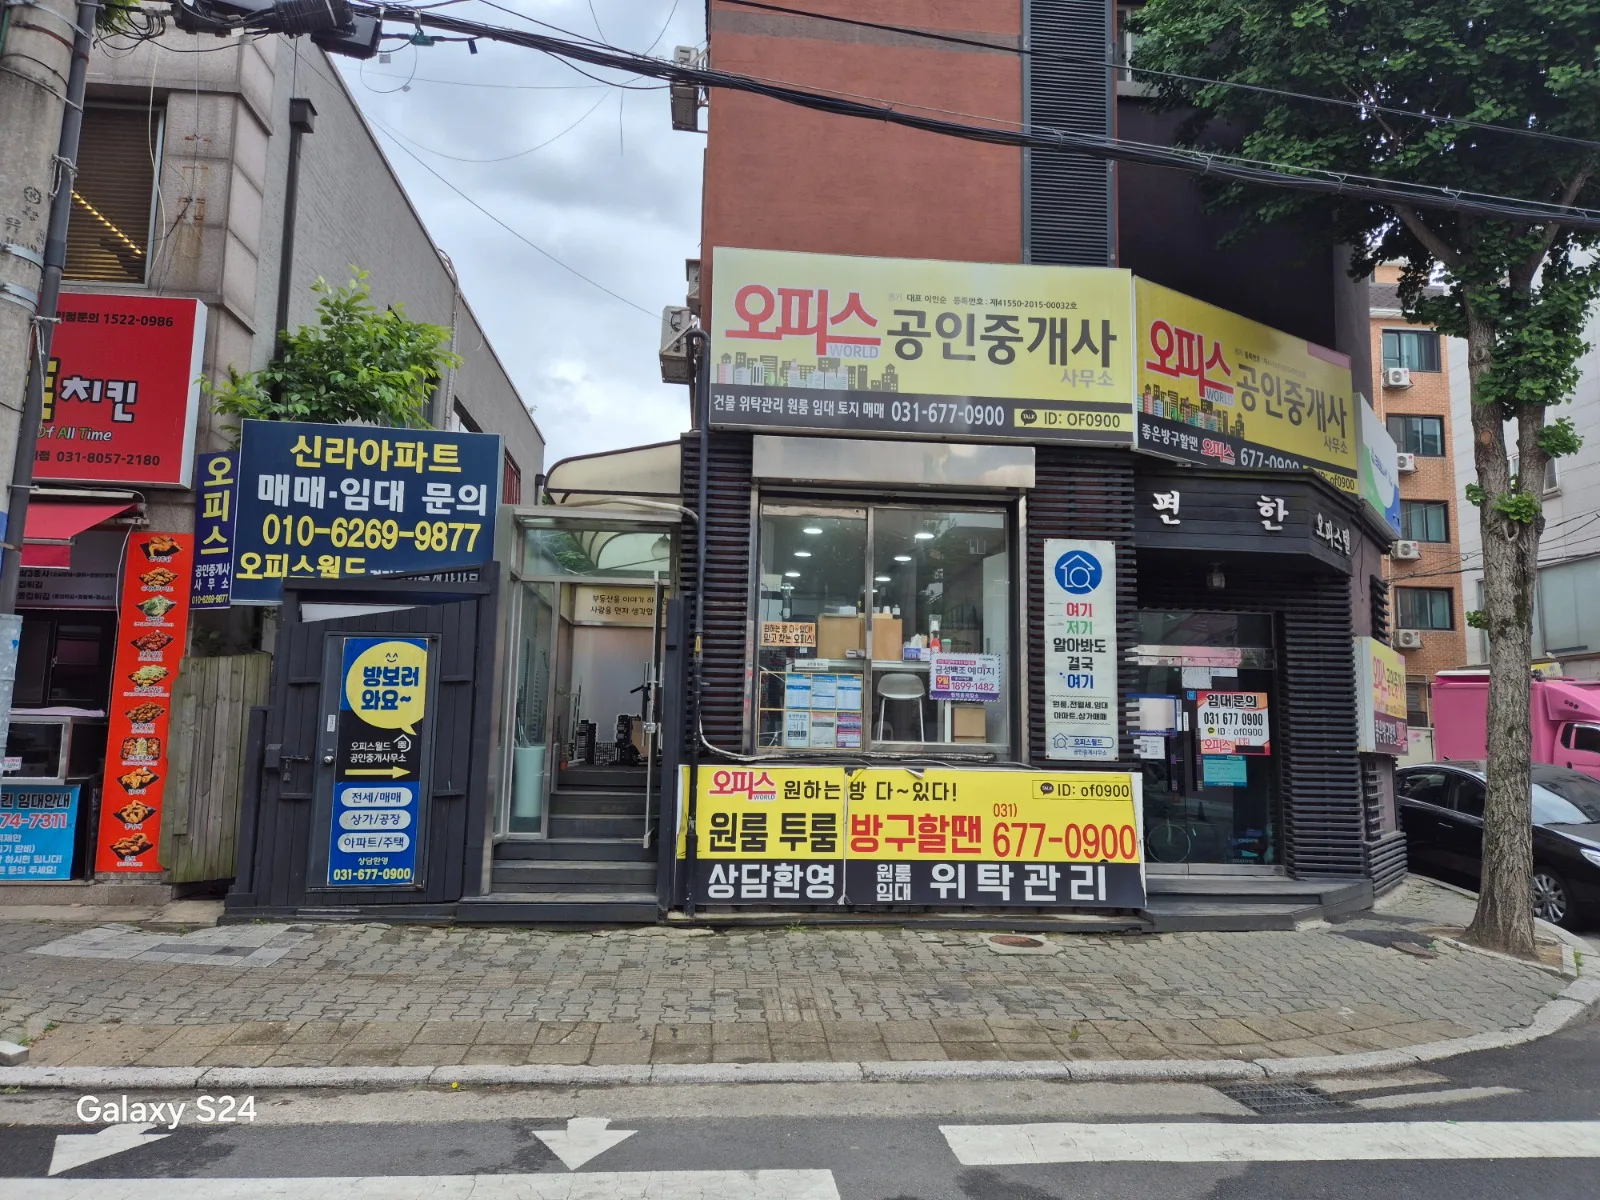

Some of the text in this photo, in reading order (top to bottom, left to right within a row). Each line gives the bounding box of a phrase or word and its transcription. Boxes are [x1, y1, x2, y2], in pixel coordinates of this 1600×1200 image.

[906, 294, 922, 303] 대표
[924, 295, 948, 305] 이인순
[989, 297, 1078, 310] 제41550-2015-00032호
[103, 313, 174, 327] 1522-0986
[725, 284, 882, 356] 오피스
[886, 309, 1118, 368] 공인중개사
[828, 345, 880, 359] WORLD
[1145, 320, 1235, 398] 오피스
[1060, 368, 1115, 389] 사무소
[1206, 387, 1235, 407] WORLD
[1236, 363, 1348, 439] 공인중개사
[714, 394, 1005, 426] 건물 위탁관리 원룸 임대 토지 매매 031-677-0900
[1044, 413, 1062, 425] ID:
[1066, 412, 1121, 428] OF0900
[57, 426, 75, 440] All
[79, 428, 112, 441] Time
[1141, 423, 1199, 452] 좋은방구할땐
[1201, 437, 1237, 464] 오피스
[1323, 434, 1349, 455] 사무소
[56, 450, 161, 466] 031-8057-2180
[289, 435, 463, 473] 신라아파트
[201, 456, 234, 555] 오피스
[421, 482, 488, 517] 문의
[262, 513, 483, 552] 010-6269-9877
[1316, 512, 1351, 555] 오피스텔
[195, 563, 231, 577] 공인중개사
[235, 552, 367, 580] 오피스월드
[191, 593, 229, 605] 010-6269-9877
[592, 595, 620, 604] 부동산을
[622, 596, 645, 604] 이야기
[590, 605, 612, 616] 사람을
[614, 606, 629, 616] 먼저
[1066, 602, 1093, 617] 여기
[1066, 620, 1093, 635] 저기
[1053, 637, 1107, 653] 알아봐도
[1067, 656, 1094, 671] 결국
[363, 666, 420, 687] 방보러
[1067, 674, 1094, 689] 여기
[950, 681, 995, 691] 1899-1482
[1206, 694, 1257, 708] 임대문의
[1203, 712, 1263, 726] 031 677 0900
[1233, 728, 1263, 736] of0900
[350, 742, 391, 751] 오피스월드
[1073, 738, 1104, 746] 오피스월드
[1204, 739, 1232, 753] 오피스
[350, 753, 407, 763] 공인중개사무소
[709, 770, 777, 799] 오피스
[784, 780, 841, 800] 원하는
[849, 781, 867, 800] 방
[1057, 783, 1076, 796] ID:
[1080, 783, 1130, 798] of0900
[18, 793, 71, 809] 임대안내
[351, 791, 402, 803] 전세/매매
[993, 803, 1018, 818] 031)
[0, 813, 67, 829] 74-7311
[350, 813, 401, 825] 상가/공장
[343, 836, 404, 849] 아파트/주택
[709, 812, 1137, 860] 원룸 투룸 방구할땐 677-0900
[5, 854, 62, 864] 하시면 됩니다!
[358, 857, 389, 866] 상담환영
[8, 866, 26, 875] 문의
[28, 866, 57, 875] 주세요!
[333, 868, 411, 881] 031-677-0900
[876, 864, 912, 882] 원룸
[707, 863, 835, 899] 상담환영
[929, 863, 1107, 901] 위탁관리
[876, 882, 912, 901] 임대
